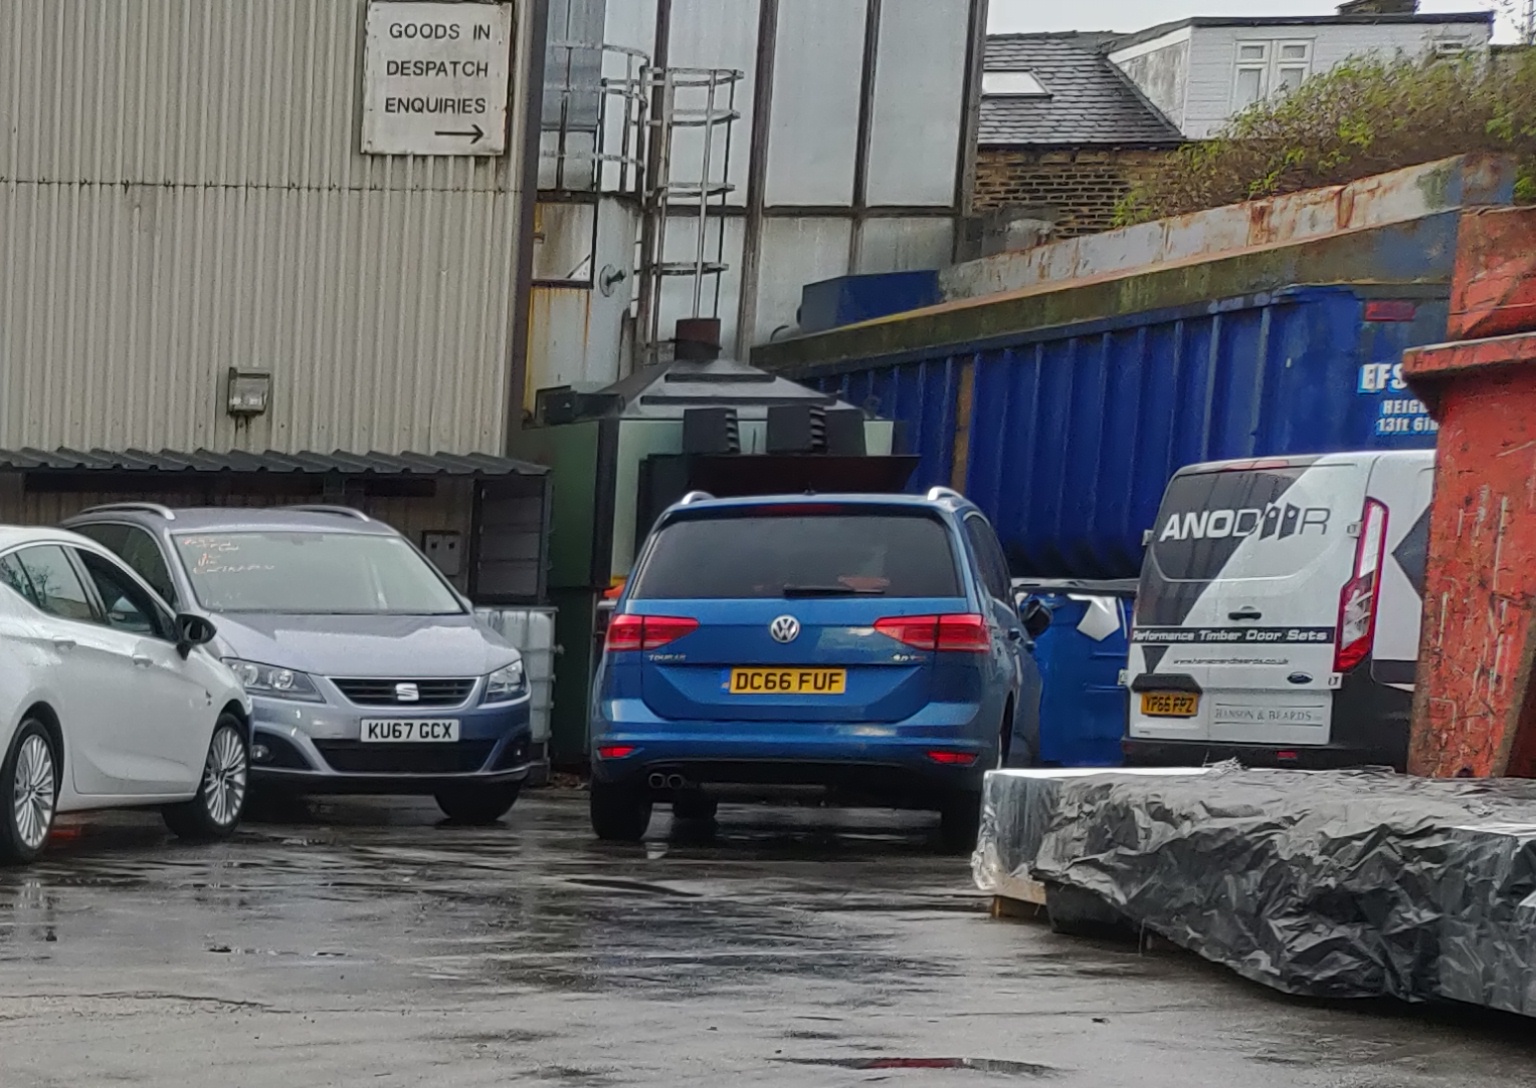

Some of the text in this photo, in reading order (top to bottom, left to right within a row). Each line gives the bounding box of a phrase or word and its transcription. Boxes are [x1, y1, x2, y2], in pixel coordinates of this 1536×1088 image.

[389, 23, 491, 40] GOODS IN
[386, 60, 489, 78] DESPATCH
[384, 97, 486, 115] ENQUIRIES
[1132, 628, 1328, 641] Performance Timber Door Sets
[735, 672, 842, 691] DC66 FUF
[368, 722, 452, 739] KU67 GCX
